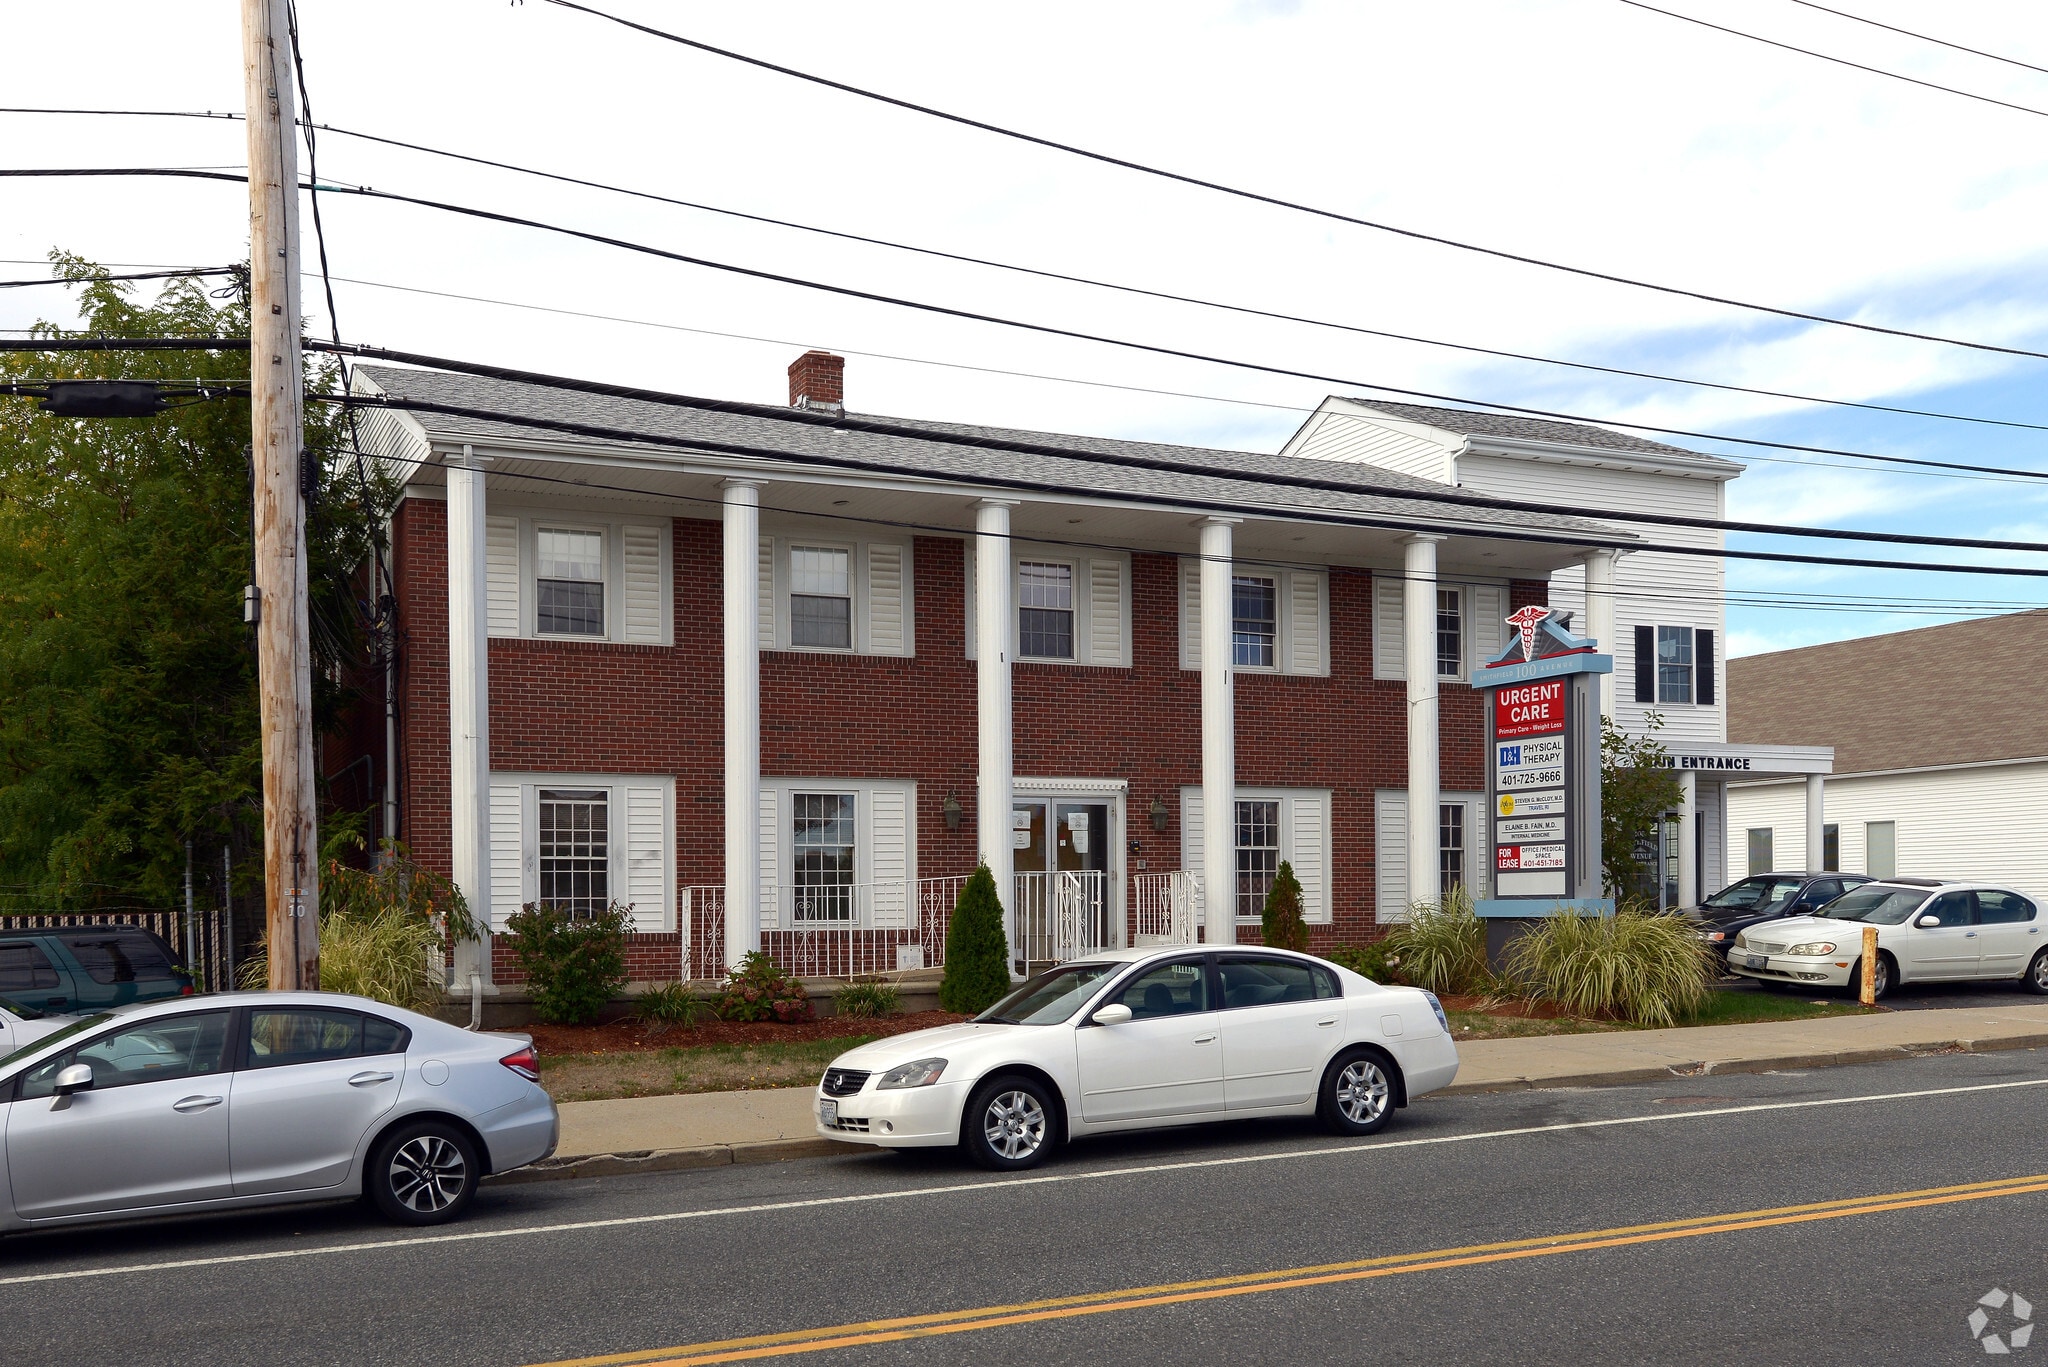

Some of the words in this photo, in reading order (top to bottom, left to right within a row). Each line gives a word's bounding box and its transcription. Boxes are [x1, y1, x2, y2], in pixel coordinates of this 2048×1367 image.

[1480, 670, 1513, 681] SMITHFIELD
[1516, 663, 1537, 678] 100
[1541, 661, 1573, 671] AVENUE
[1501, 683, 1561, 706] URGENT
[1511, 703, 1550, 722] CARE
[1523, 741, 1562, 753] PHYSICAL
[1523, 752, 1560, 764] THERAPY
[1682, 757, 1750, 769] ENTRANCE
[1502, 770, 1561, 786] 401-725-9666
[1505, 823, 1523, 831] ELAINE
[1499, 848, 1512, 858] FOR
[1499, 858, 1519, 869] LEASE
[1524, 858, 1563, 867] 401-451-7185
